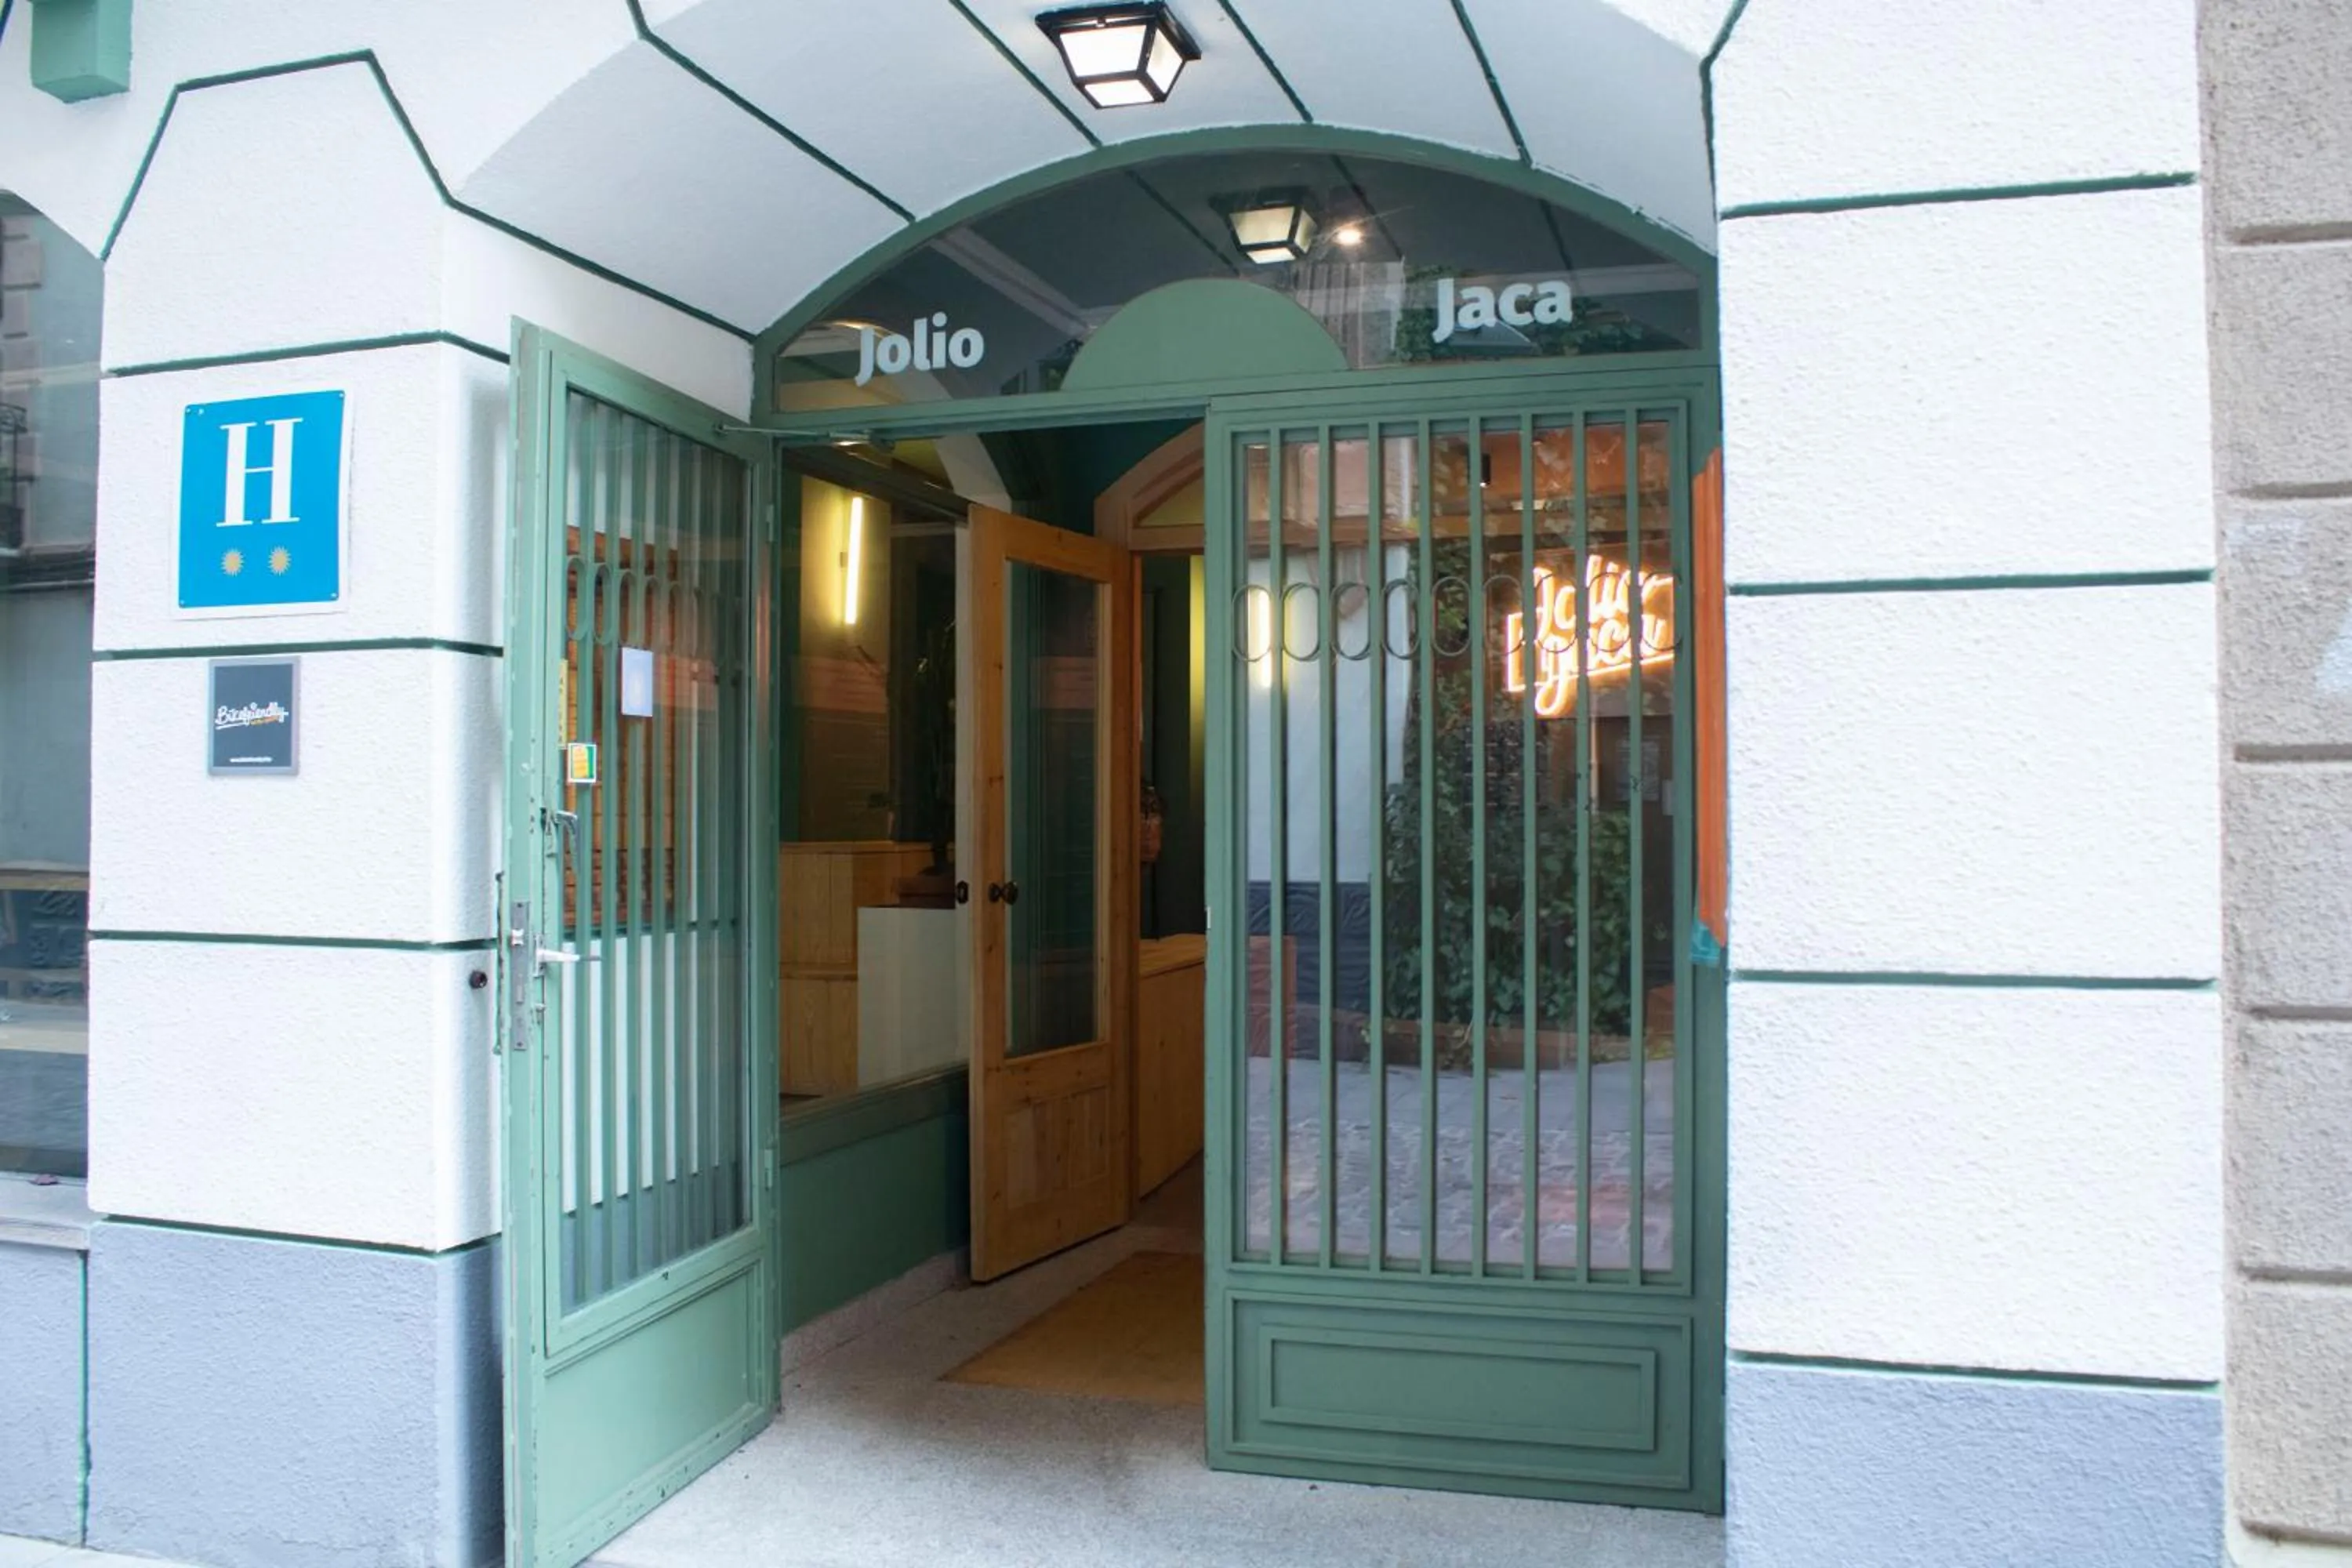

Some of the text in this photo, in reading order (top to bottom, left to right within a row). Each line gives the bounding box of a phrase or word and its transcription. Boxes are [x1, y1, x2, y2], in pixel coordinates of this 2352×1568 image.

[855, 278, 1573, 387] Jolio Jaca
[216, 417, 303, 528] H
